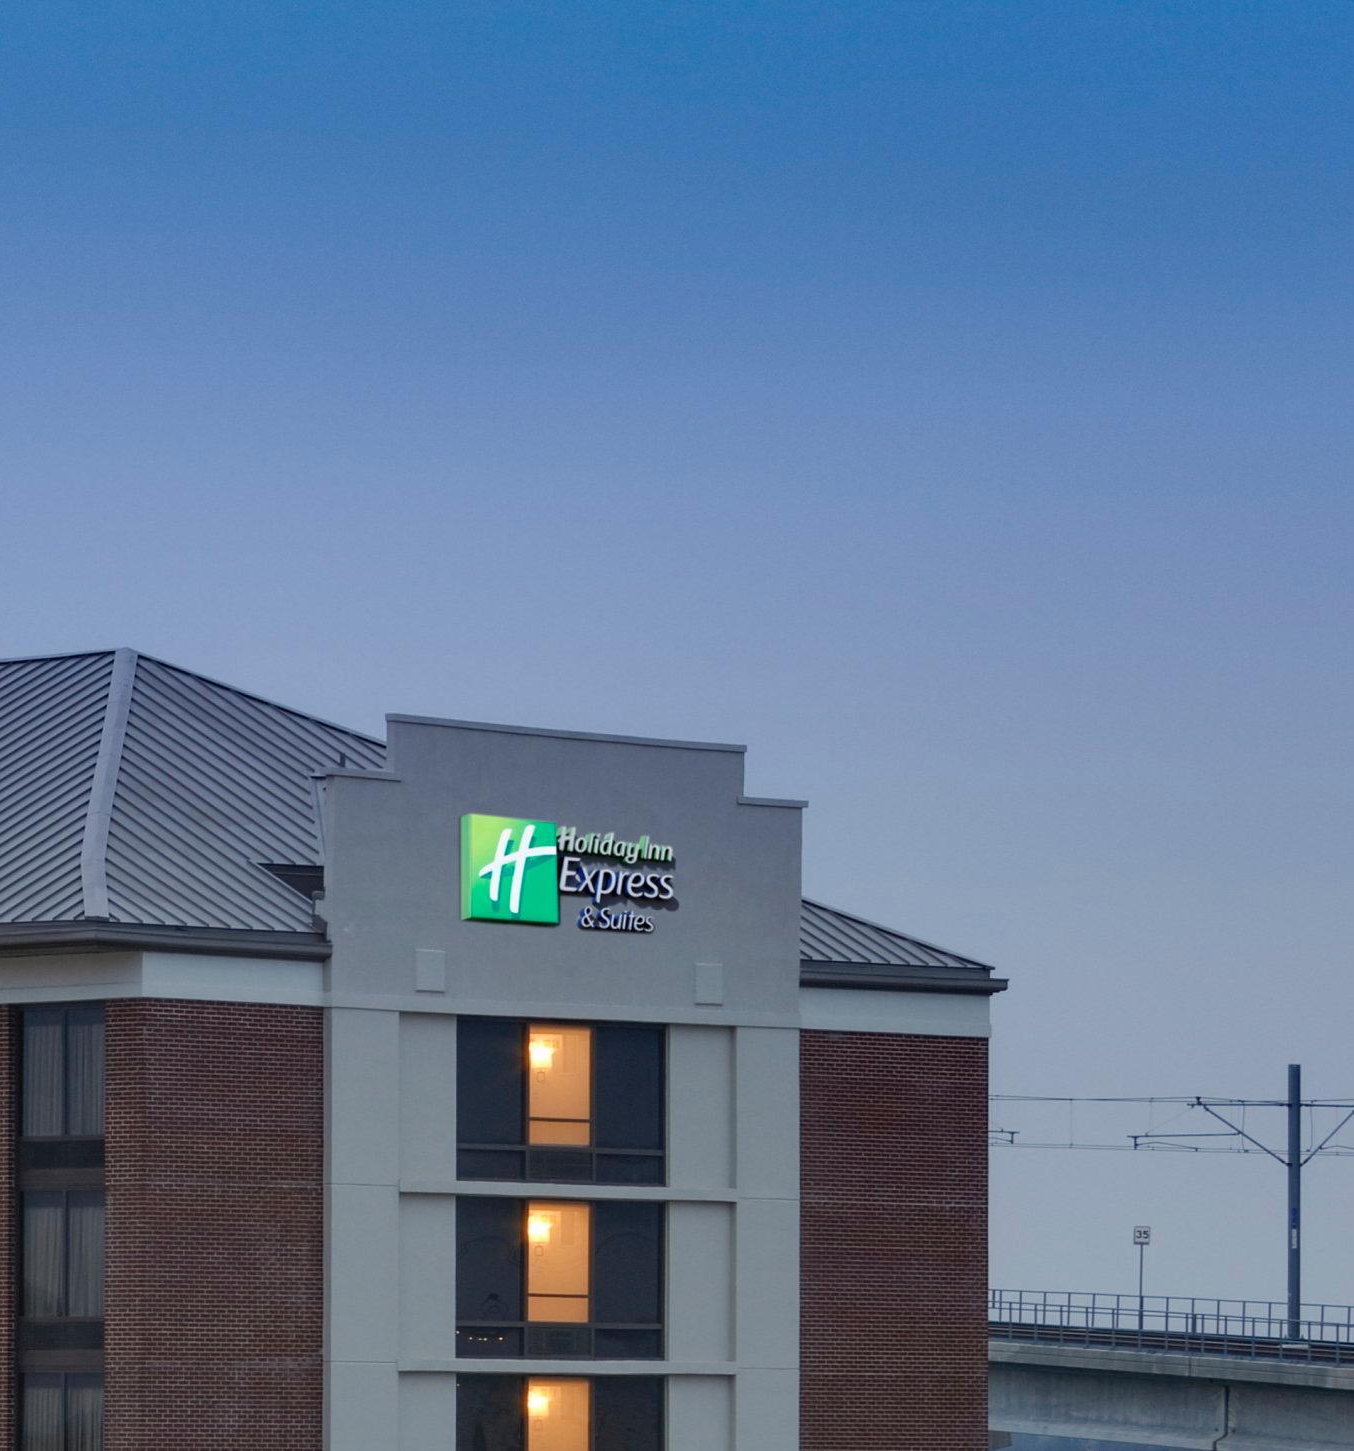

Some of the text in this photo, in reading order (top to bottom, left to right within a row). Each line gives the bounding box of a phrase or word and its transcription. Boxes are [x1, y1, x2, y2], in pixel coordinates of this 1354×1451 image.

[558, 825, 674, 864] Holiday Inn
[559, 856, 675, 904] Express
[580, 906, 655, 933] & Suites
[1136, 1230, 1149, 1239] 35
